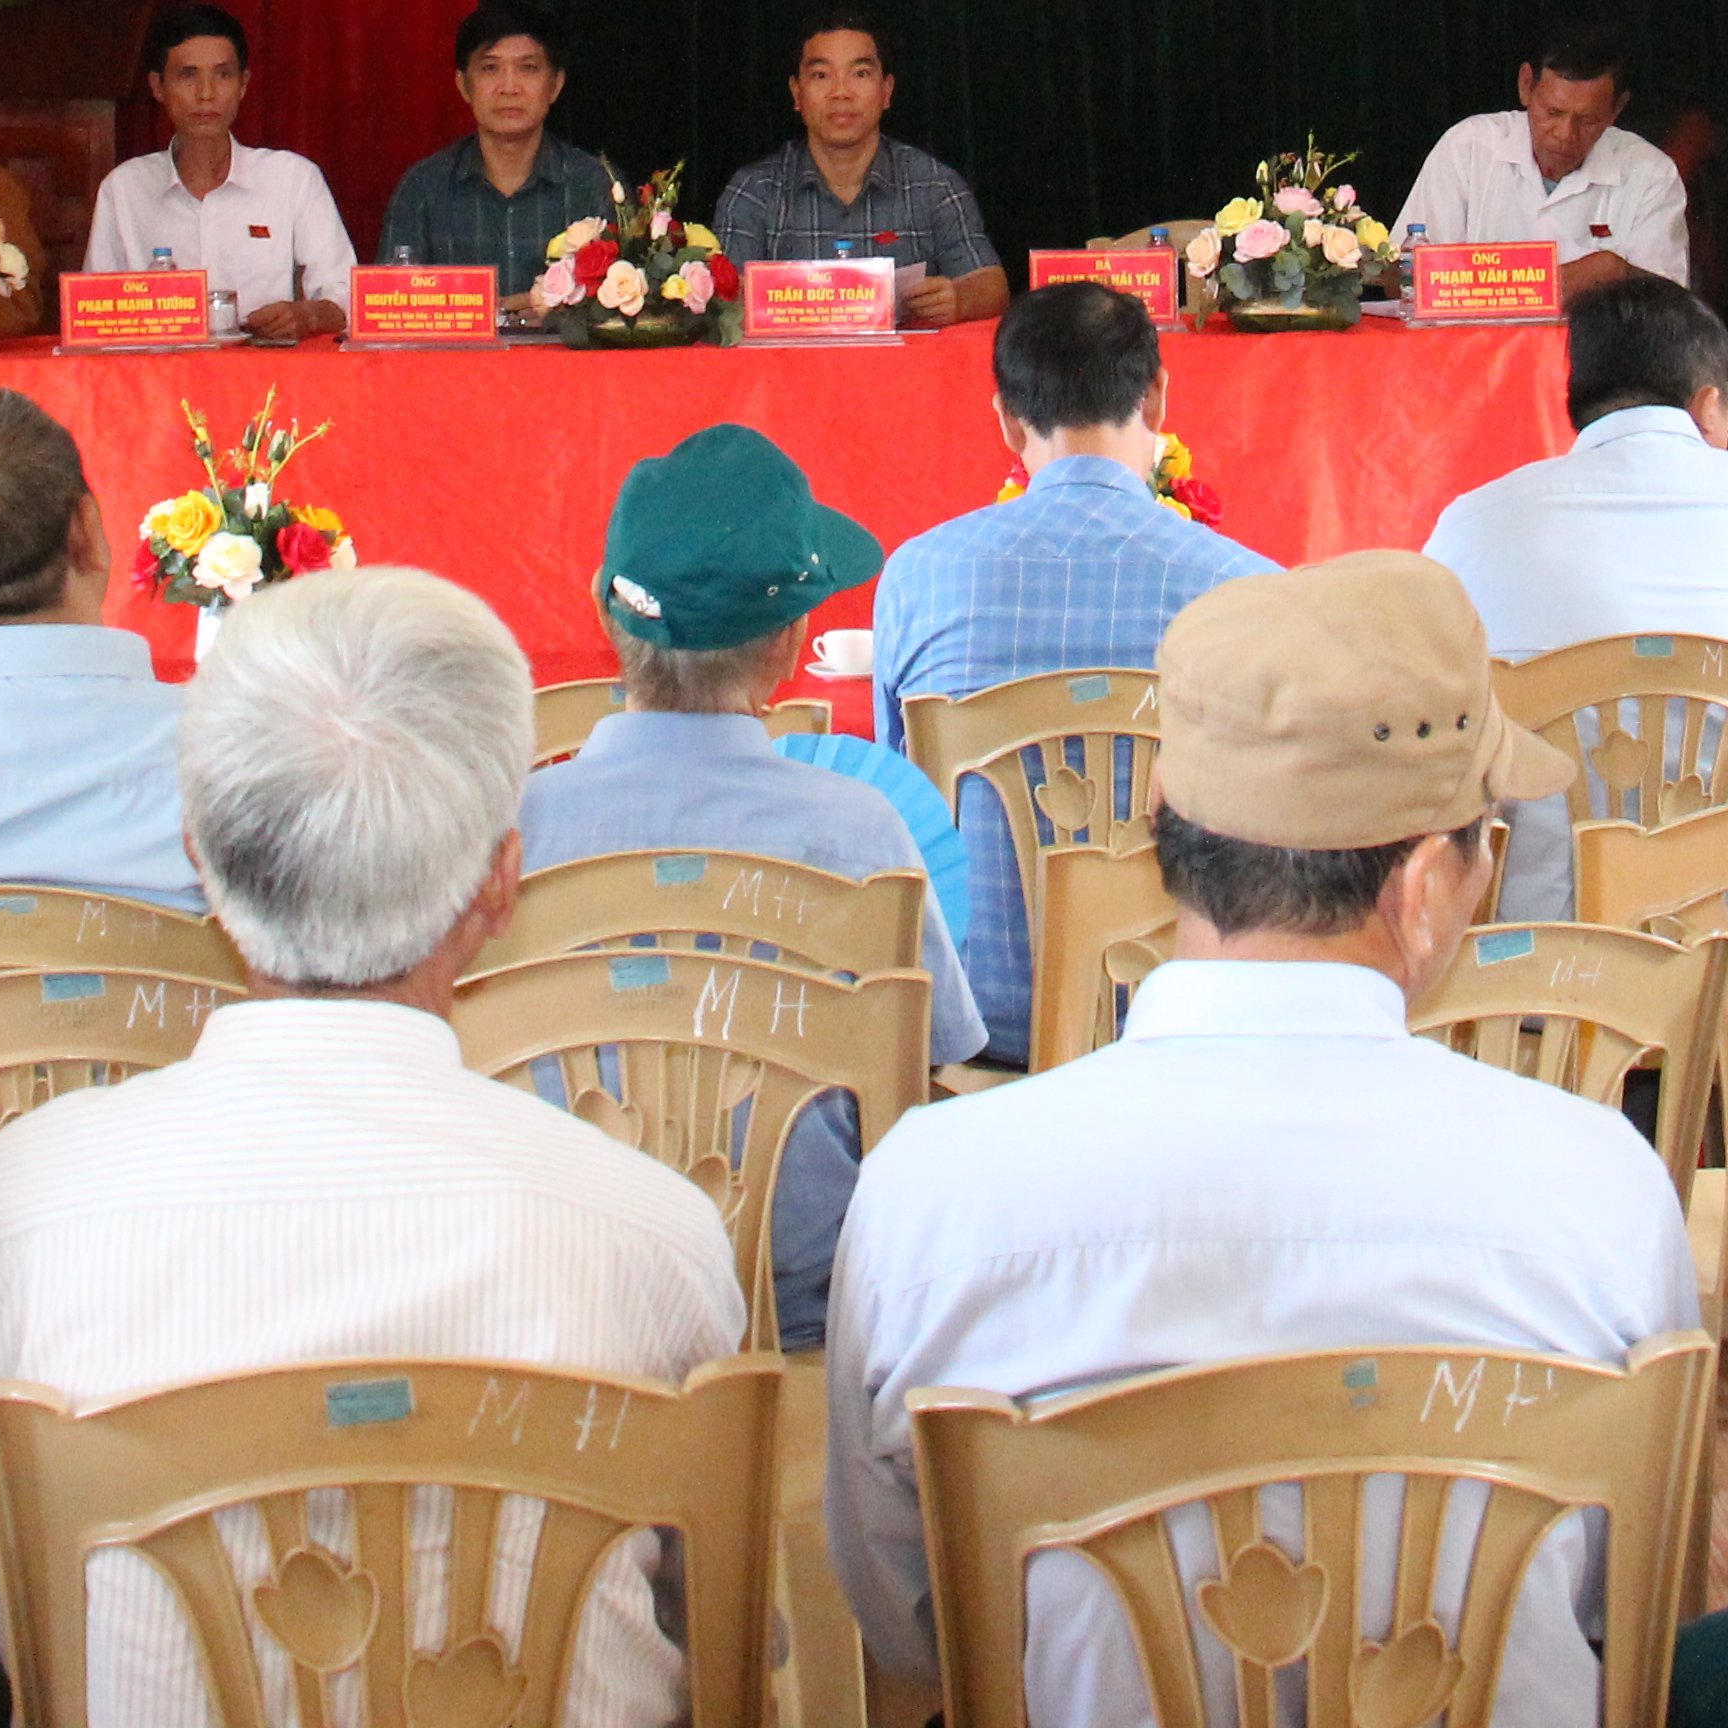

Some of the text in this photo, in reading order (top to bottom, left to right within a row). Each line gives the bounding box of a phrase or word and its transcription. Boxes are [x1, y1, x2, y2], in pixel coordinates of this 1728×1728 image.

[1095, 258, 1111, 270] BÀ
[1472, 250, 1501, 265] ÔNG
[411, 275, 437, 287] ÔNG
[1135, 270, 1160, 286] YẾN
[1429, 270, 1474, 287] PHẠM
[1477, 268, 1508, 283] VĂN
[123, 281, 148, 293] ÔNG
[365, 290, 484, 307] NGUYỄN QUANG TRUNG
[77, 299, 114, 315] PHẠM
[116, 298, 153, 314] MẠNH
